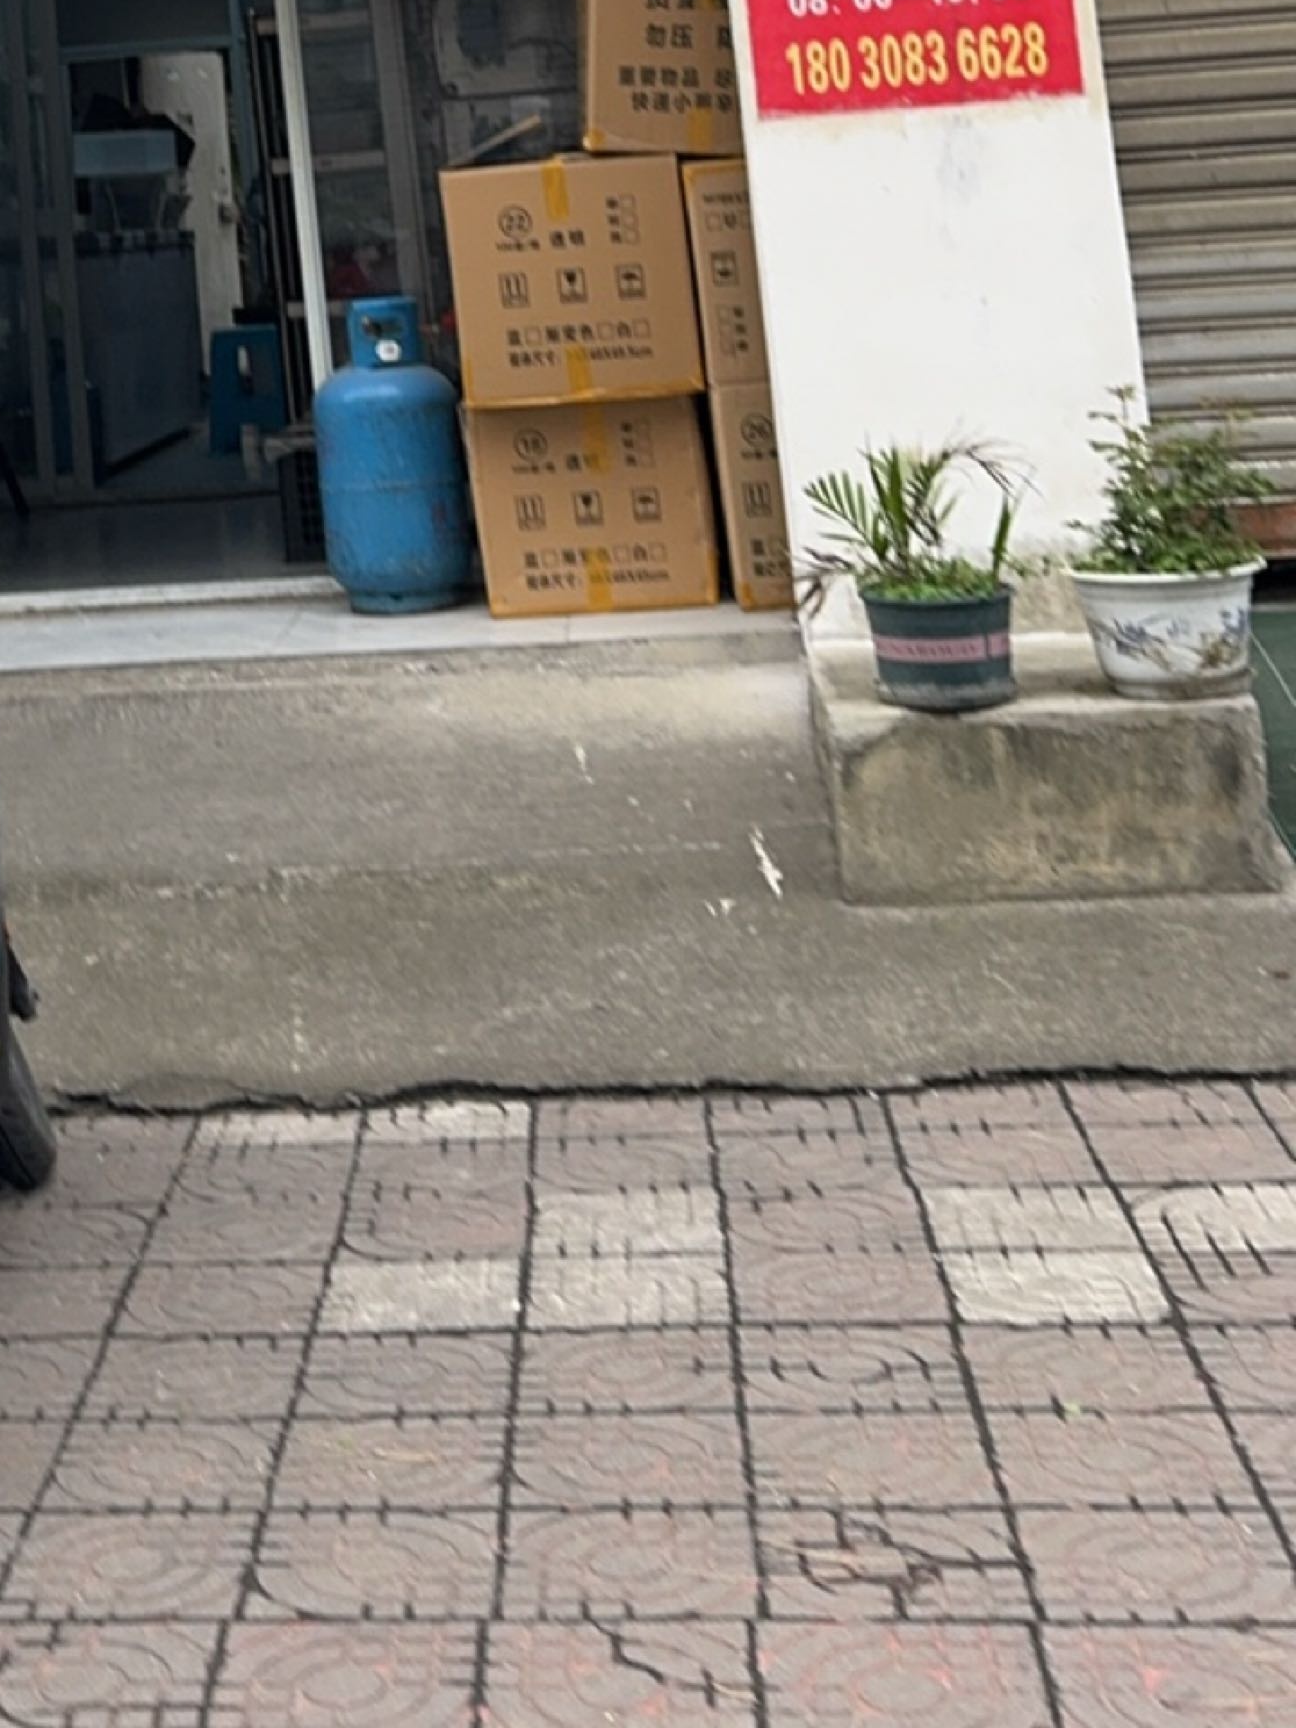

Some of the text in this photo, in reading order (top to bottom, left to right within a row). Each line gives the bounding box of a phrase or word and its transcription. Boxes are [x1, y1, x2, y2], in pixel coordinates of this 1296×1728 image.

[785, 21, 1049, 96] 180 3083 6628
